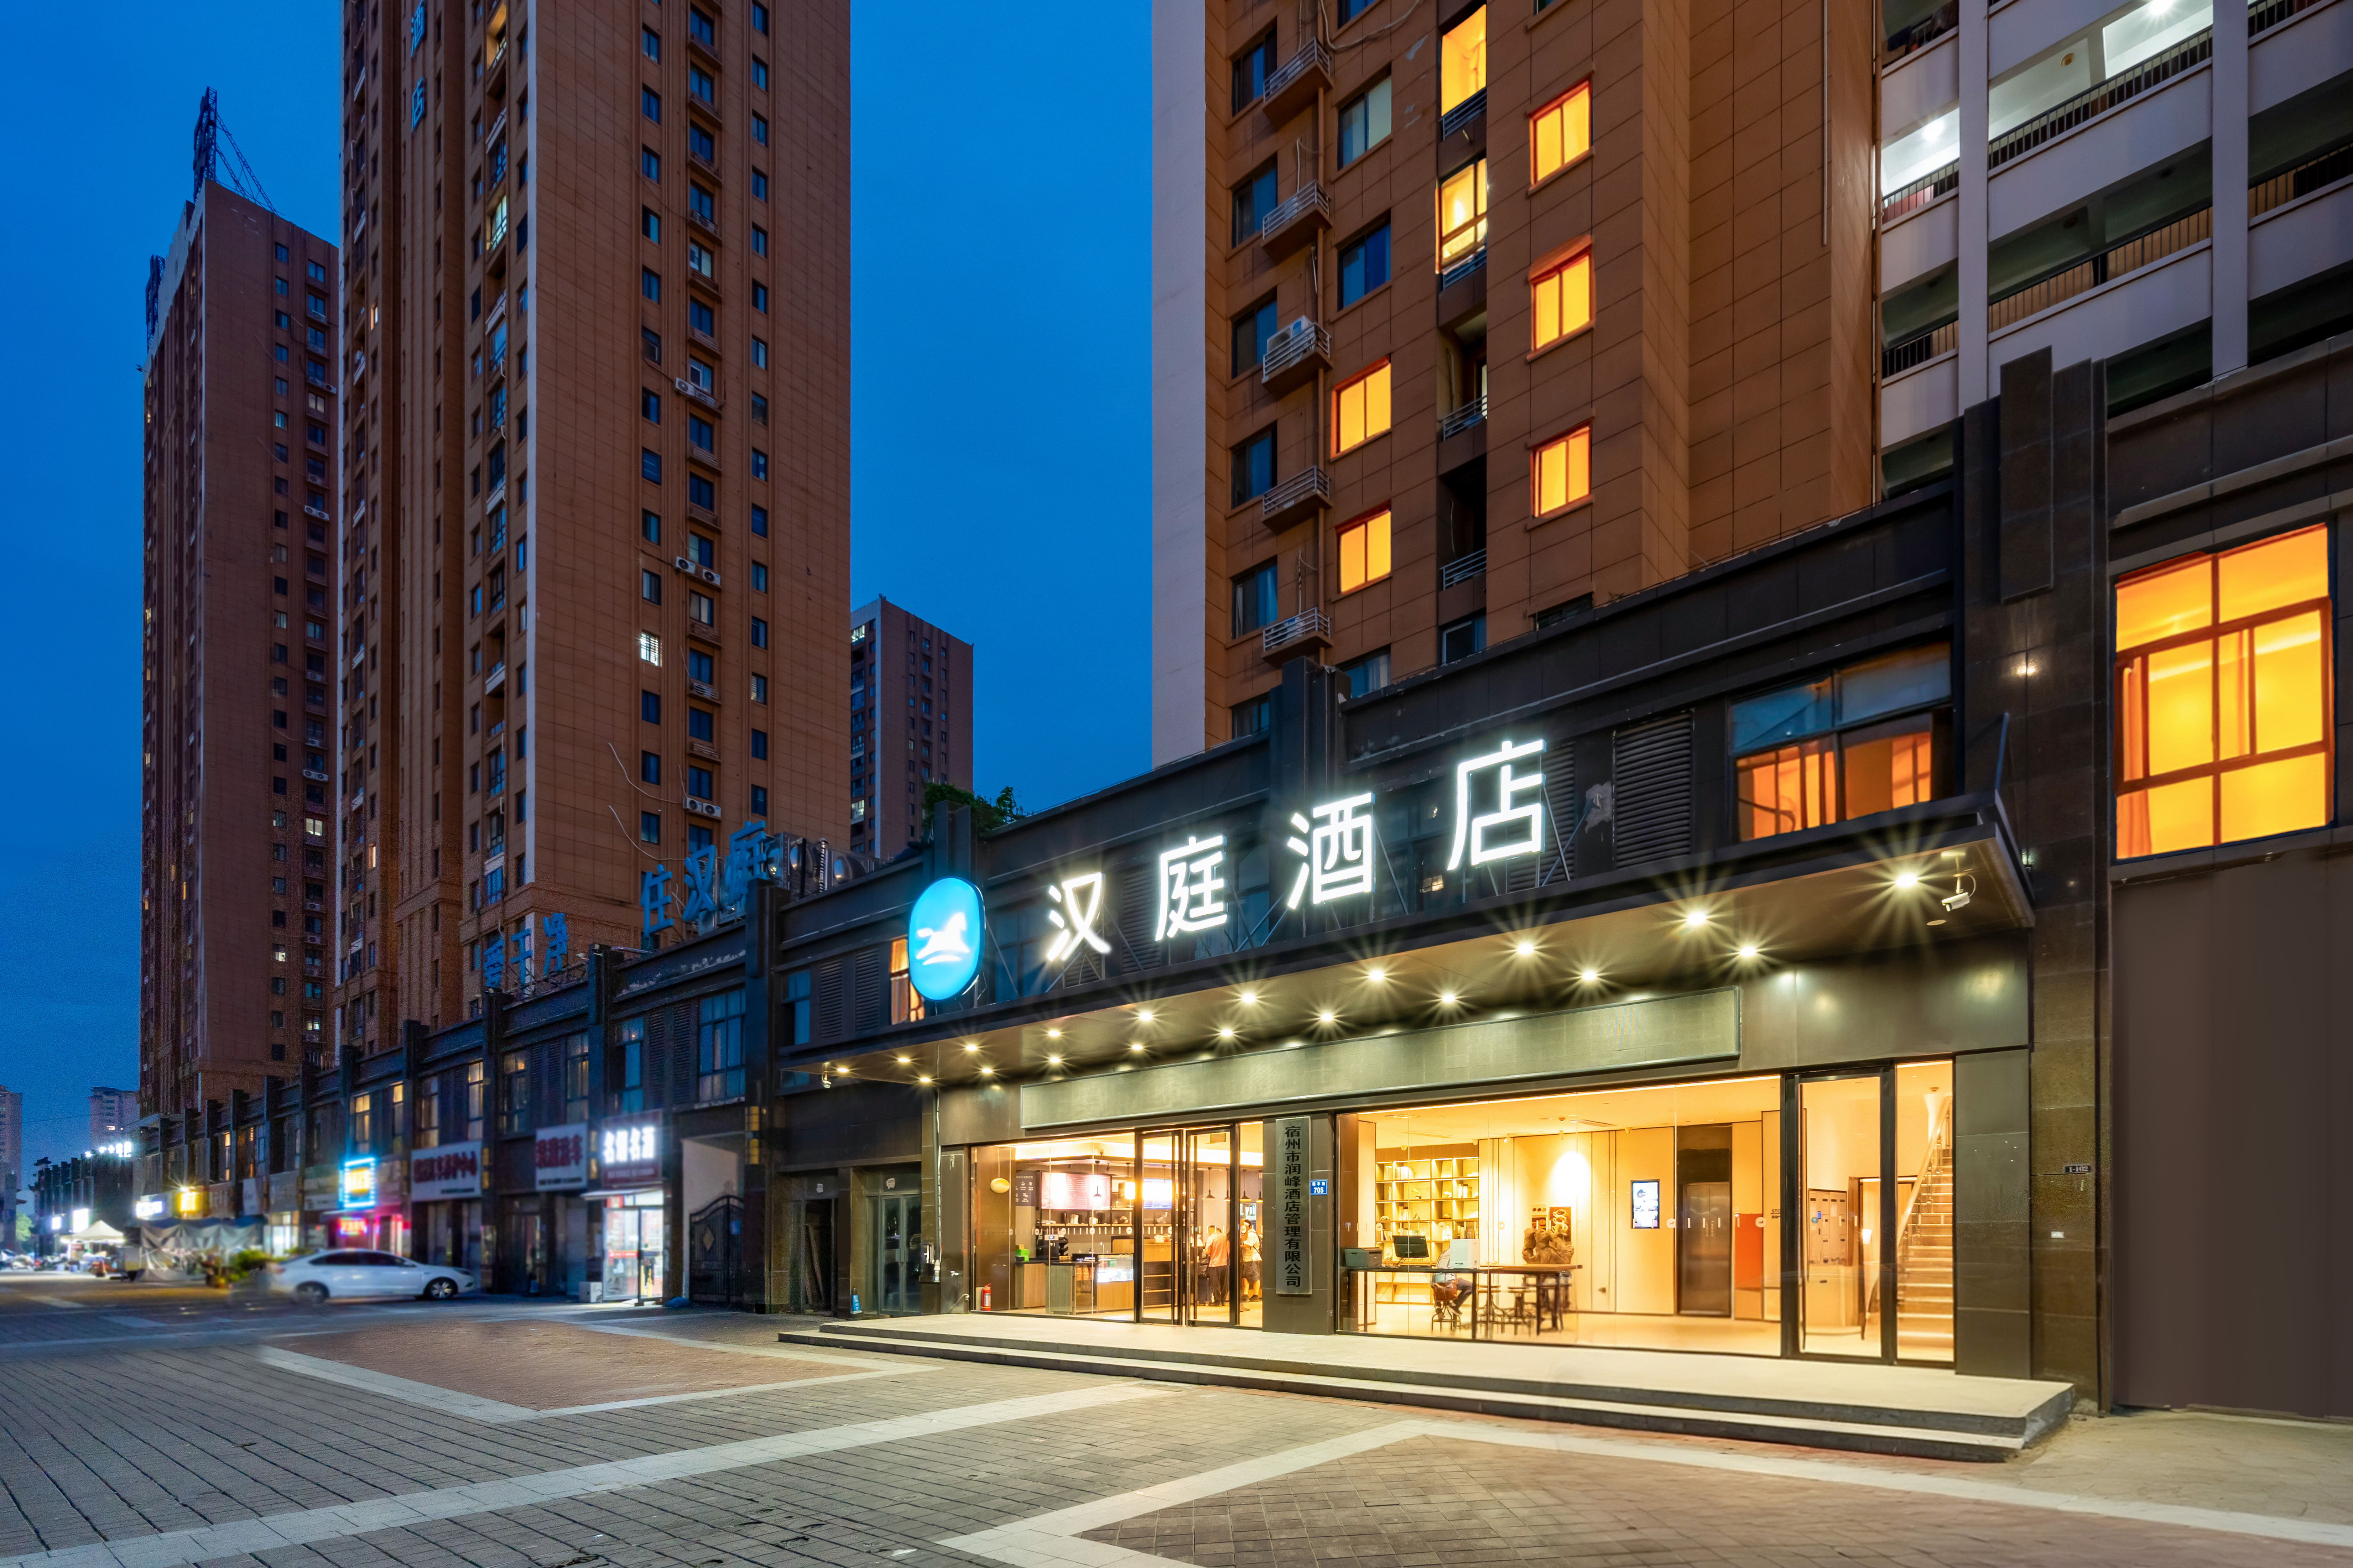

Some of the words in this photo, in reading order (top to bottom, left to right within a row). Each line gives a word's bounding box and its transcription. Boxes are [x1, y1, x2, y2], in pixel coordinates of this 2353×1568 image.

[640, 820, 769, 938] 住汉庭
[1046, 739, 1547, 961] 汉庭酒店
[1284, 1126, 1301, 1287] 宿州市润峰酒店管理有限公司
